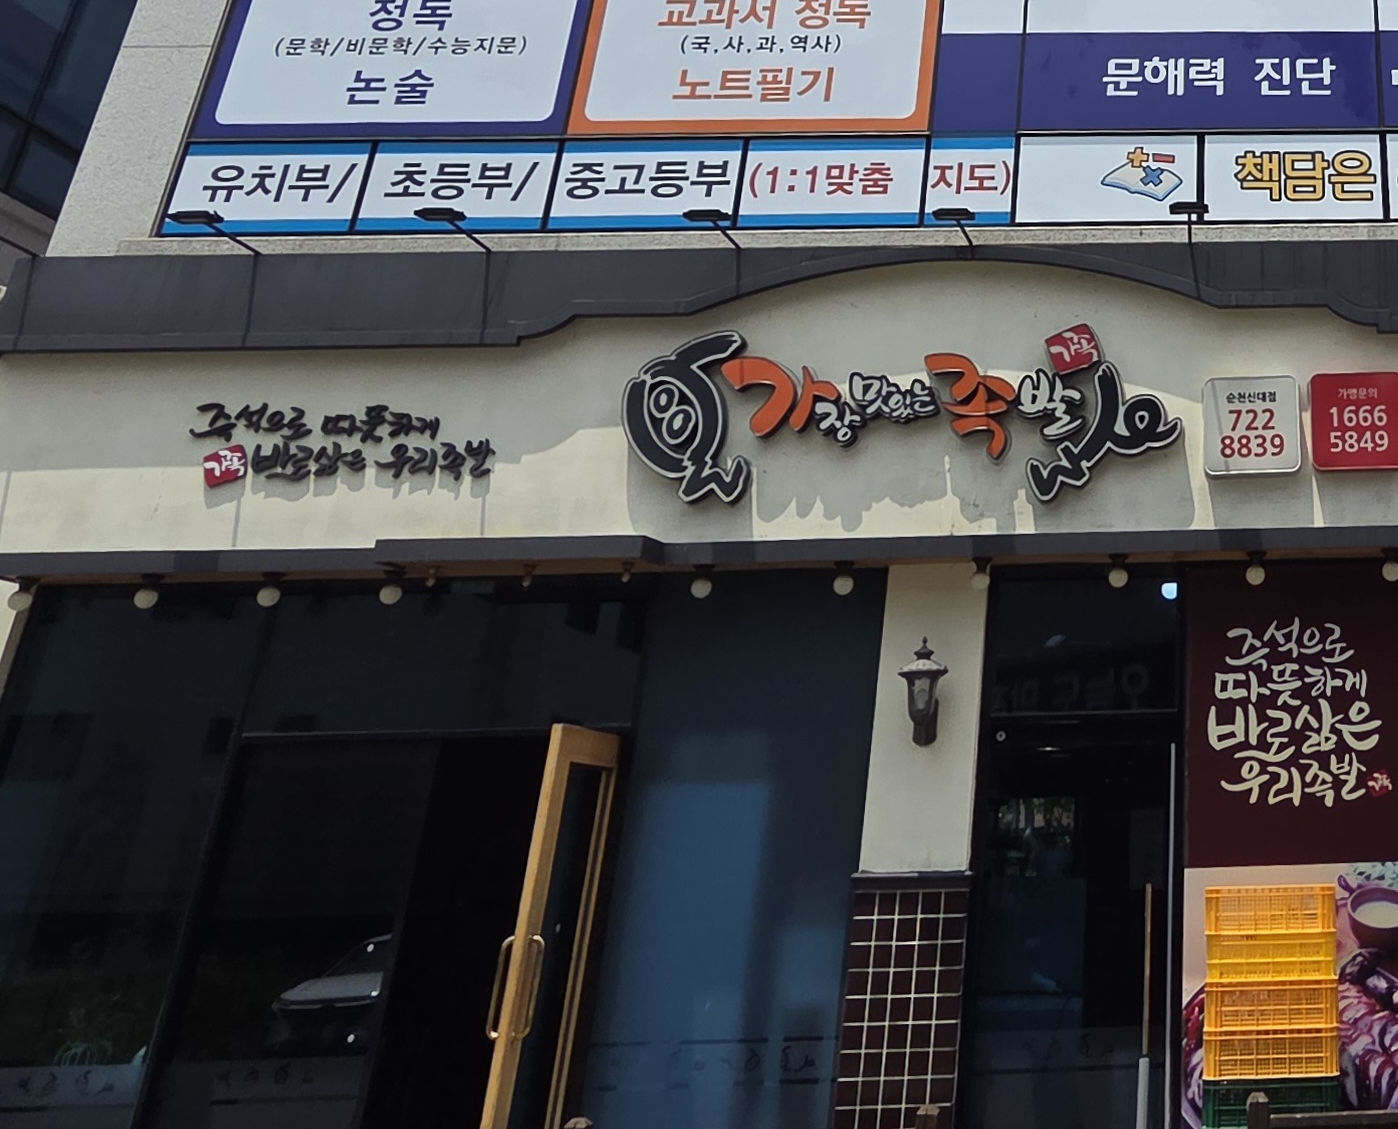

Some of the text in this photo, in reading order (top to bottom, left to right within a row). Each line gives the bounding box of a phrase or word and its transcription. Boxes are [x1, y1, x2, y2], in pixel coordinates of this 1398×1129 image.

[274, 36, 527, 57] (문학/비문학/수능지문)
[346, 69, 435, 106] 논술
[672, 66, 835, 103] 노트필기
[1102, 56, 1226, 97] 문해력
[1254, 56, 1336, 97] 진단
[202, 160, 1012, 204] 유치부/ 초등부/ 중고등부 (1:1맞춤 지도)
[1225, 390, 1277, 404] 순천신대점
[1338, 387, 1378, 400] 가맹문의
[1227, 408, 1276, 432] 722
[1329, 405, 1387, 428] 1666
[1219, 433, 1286, 459] 8839
[1329, 430, 1389, 453] 5849
[1225, 617, 1355, 671] 즉석으로
[1214, 663, 1368, 707] 따뜻하게
